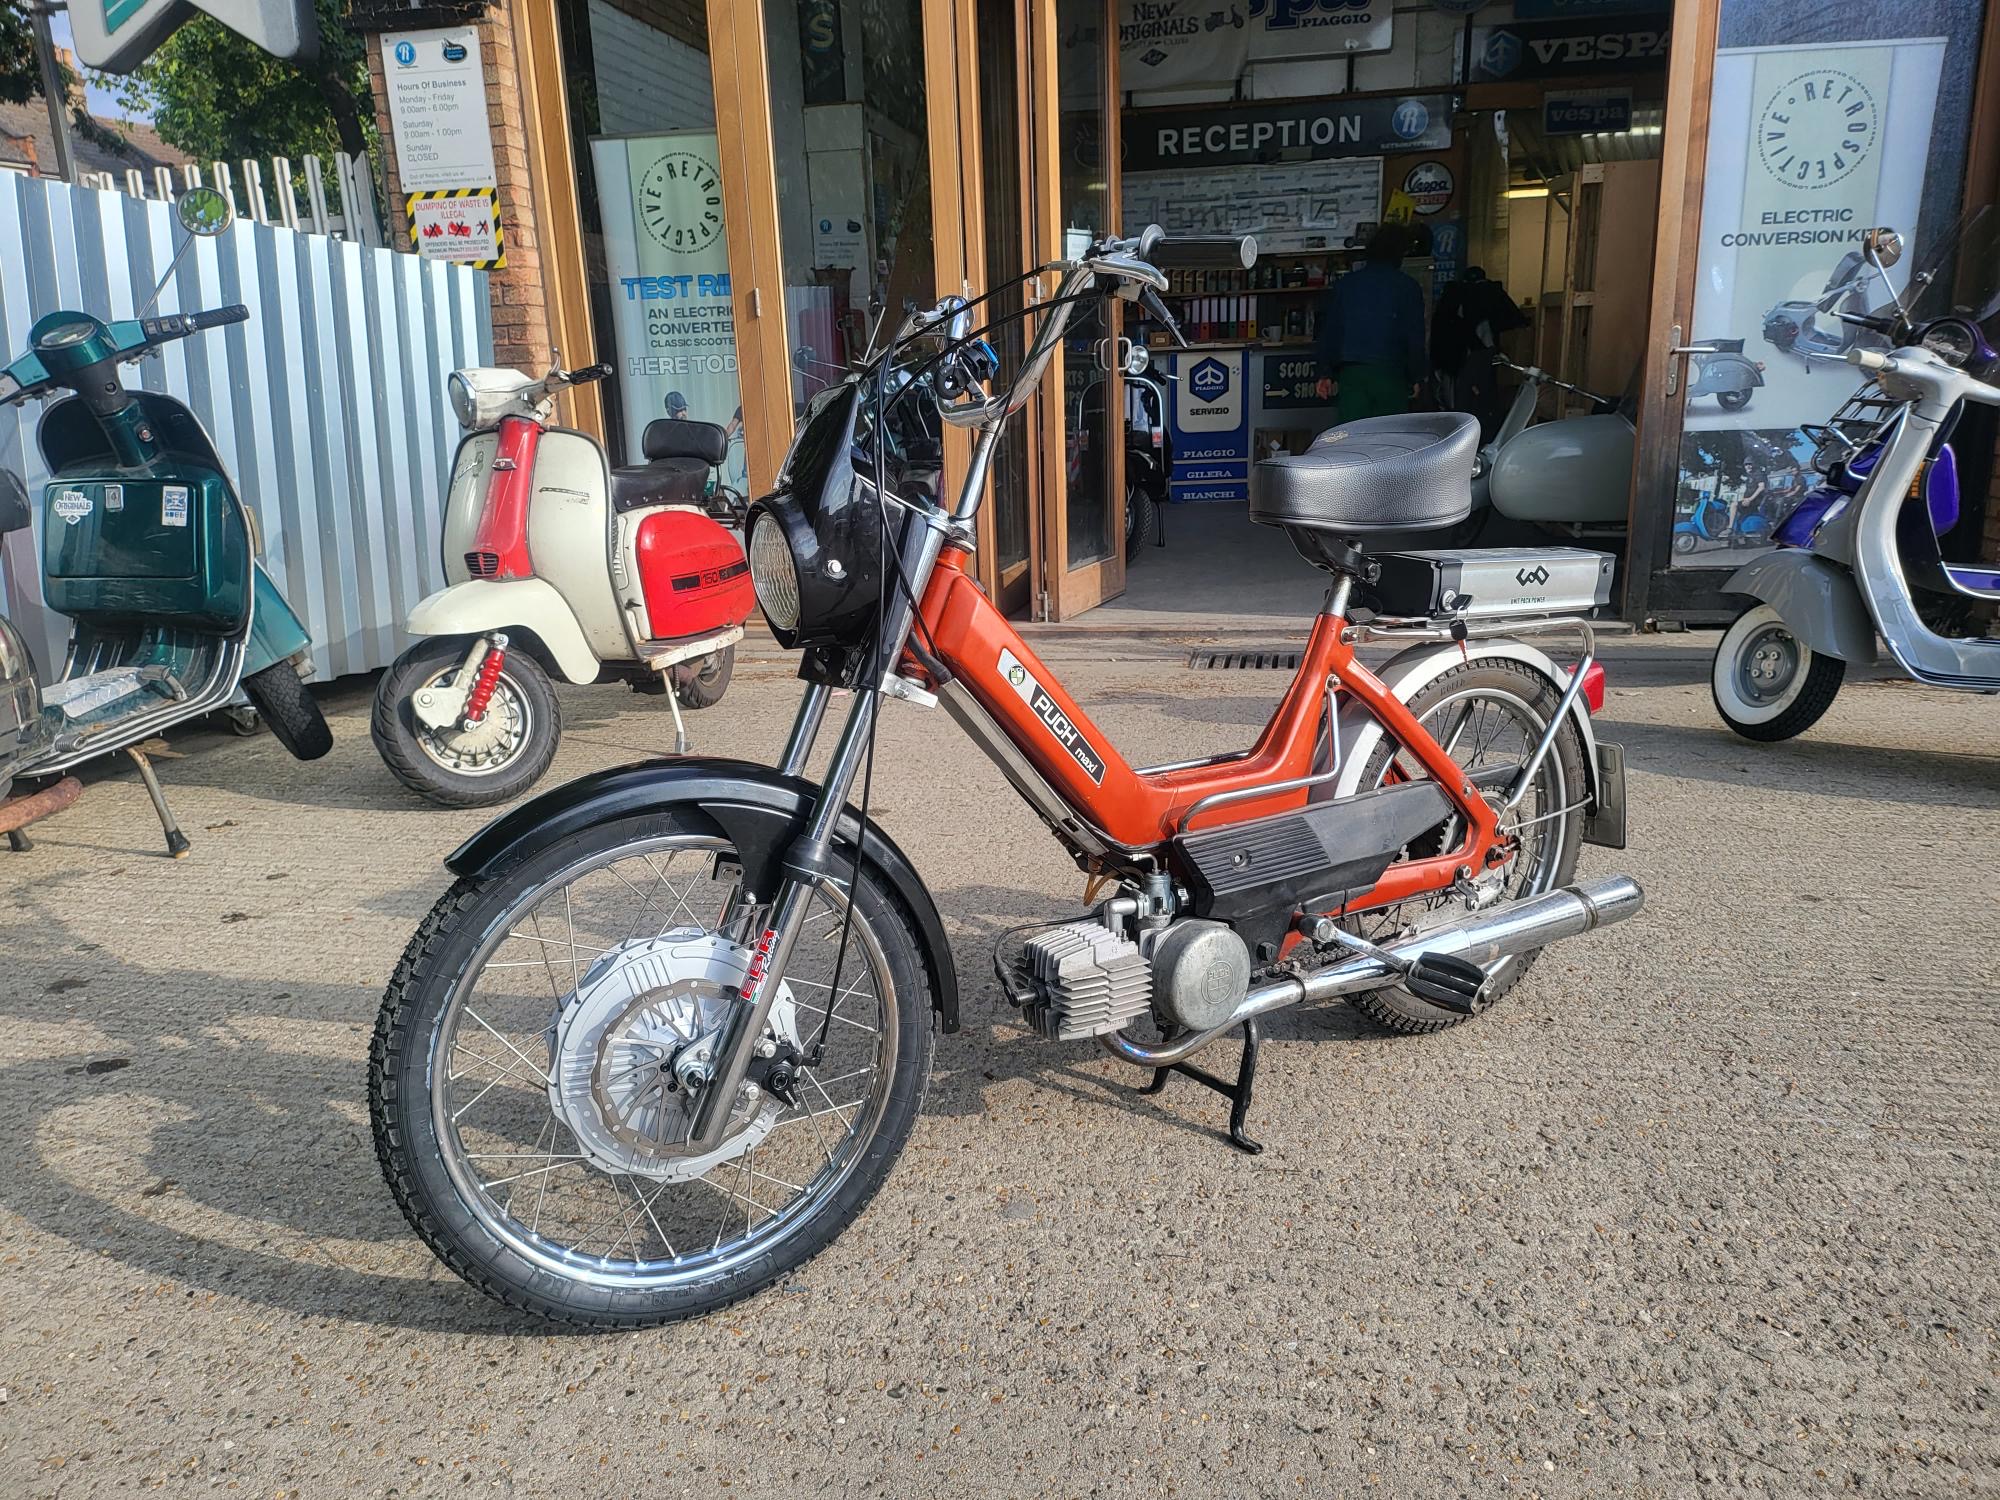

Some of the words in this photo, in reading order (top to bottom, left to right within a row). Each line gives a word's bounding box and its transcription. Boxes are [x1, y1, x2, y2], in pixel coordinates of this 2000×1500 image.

[1133, 1, 1176, 20] NEW
[1301, 13, 1371, 27] PIAGGIO
[397, 82, 420, 92] Hours
[421, 81, 430, 89] Of
[432, 79, 467, 89] Business
[398, 94, 427, 105] Monday
[432, 92, 455, 103] Friday
[1551, 106, 1625, 124] vespa
[402, 119, 434, 130] Saturday
[1766, 79, 1868, 180] RETROSPECTIVE
[1157, 115, 1362, 156] RECEPTION
[406, 143, 433, 154] Sunday
[407, 152, 439, 162] CLOSED
[1408, 170, 1449, 193] Vespa
[415, 200, 448, 212] DUMPING
[448, 200, 458, 210] OF
[459, 199, 481, 209] WASTE
[481, 198, 489, 208] IS
[645, 159, 721, 247] RETROSPECTIVE
[440, 209, 466, 219] ILLEGAL
[1761, 208, 1853, 225] ELECTRIC
[1720, 229, 1844, 247] CONVERSION
[620, 275, 693, 300] TEST
[648, 308, 669, 320] AN
[650, 338, 693, 348] CLASSIC
[628, 355, 690, 376] HERE
[1189, 407, 1230, 416] SERVIZIO
[1183, 449, 1236, 458] PIAGGIO
[1186, 470, 1233, 479] GILERA
[64, 493, 81, 501] NEW
[1183, 491, 1236, 500] BIANCHI
[1520, 596, 1531, 605] PACK
[1531, 596, 1546, 604] POWER
[1033, 694, 1078, 747] PUCH
[1074, 747, 1098, 774] maxi
[741, 928, 775, 1001] EBR
